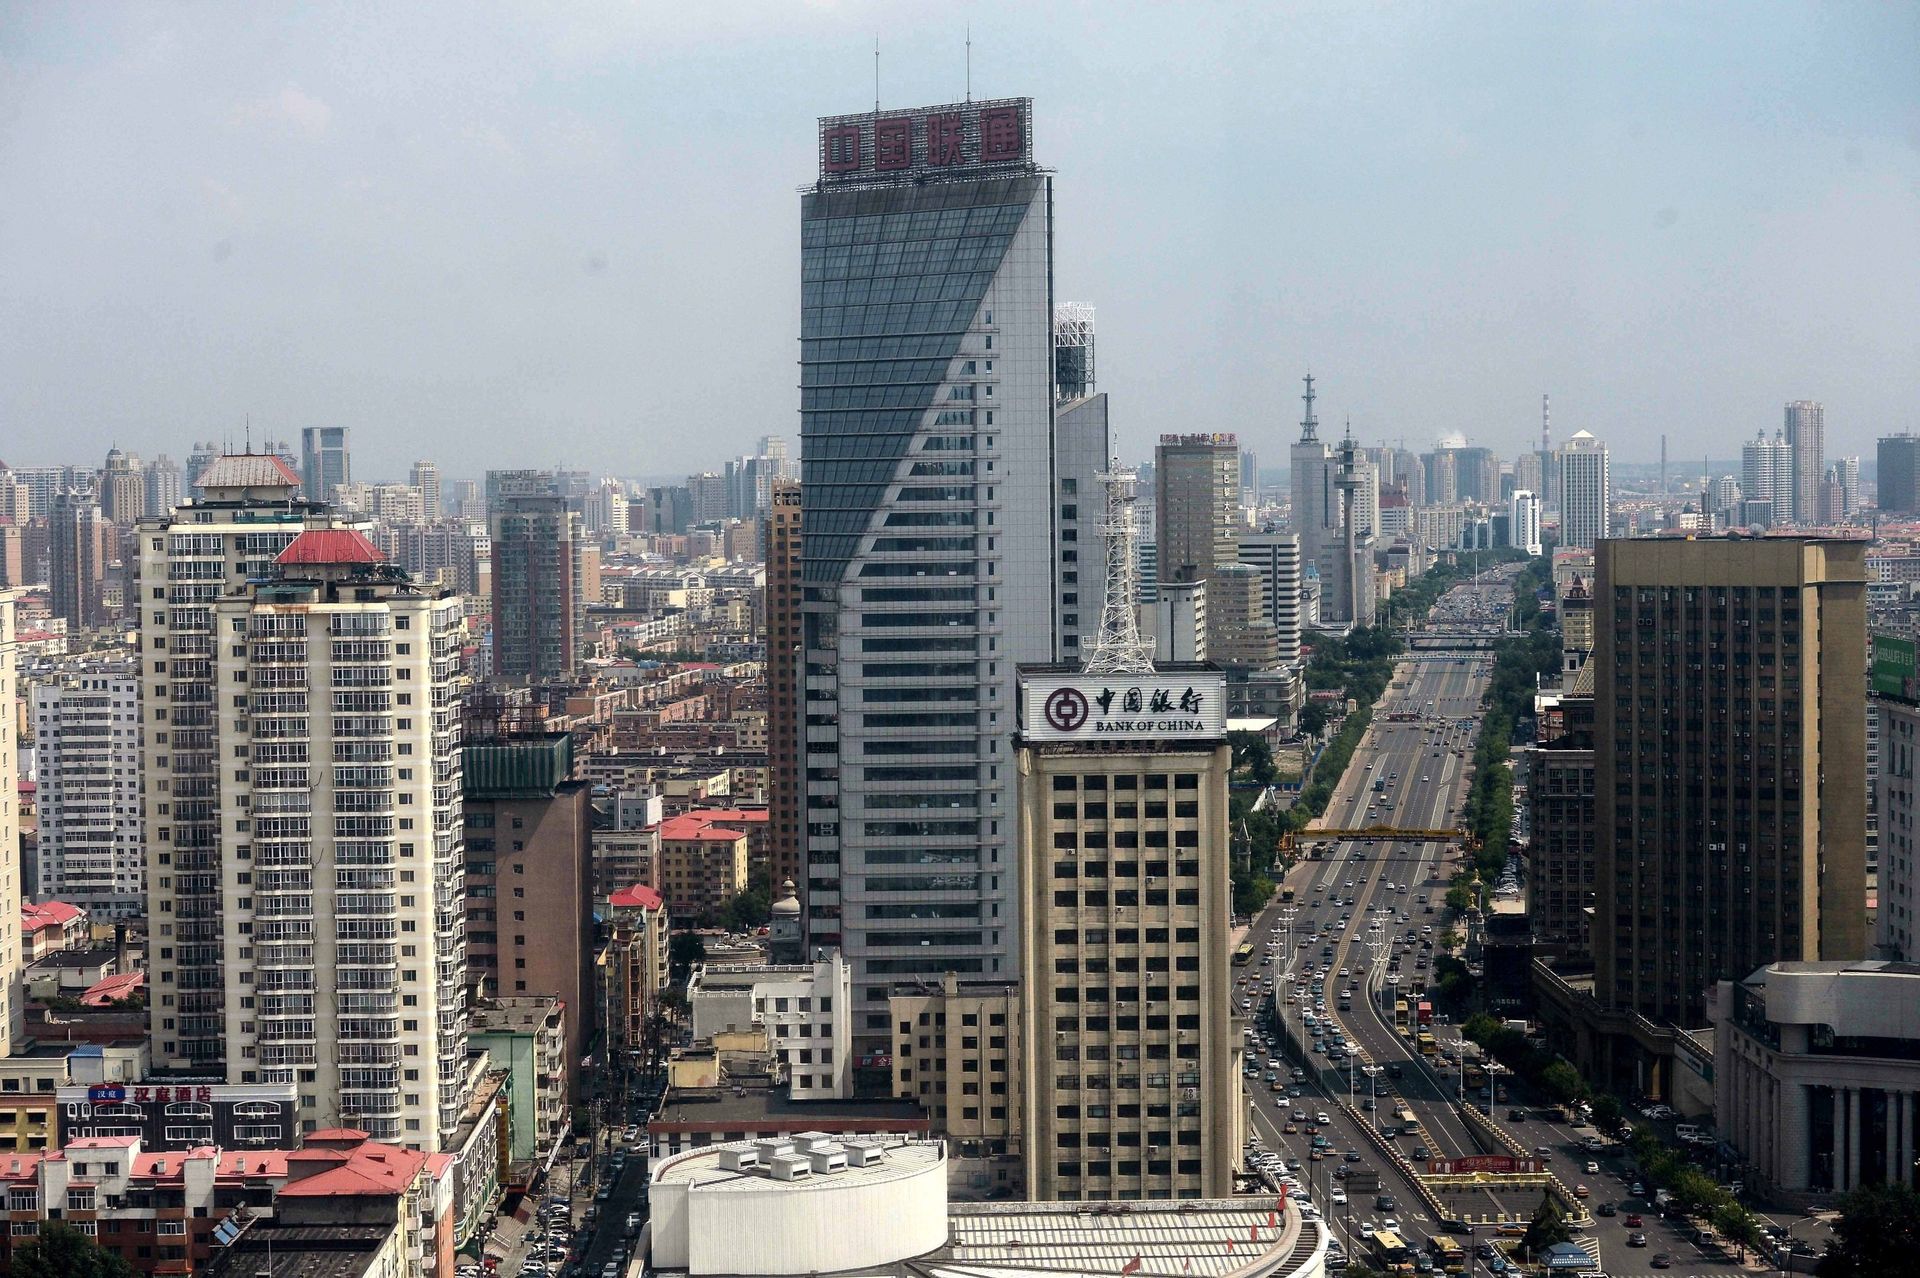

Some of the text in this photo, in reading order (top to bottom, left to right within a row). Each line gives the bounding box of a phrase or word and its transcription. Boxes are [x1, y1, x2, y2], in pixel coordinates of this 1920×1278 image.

[824, 105, 1020, 173] 中国联通
[1096, 686, 1204, 715] 中国银行
[1096, 720, 1204, 732] BANK OF CHINA
[97, 1090, 117, 1098] 汉庭
[134, 1086, 211, 1103] 汉庭酒店
